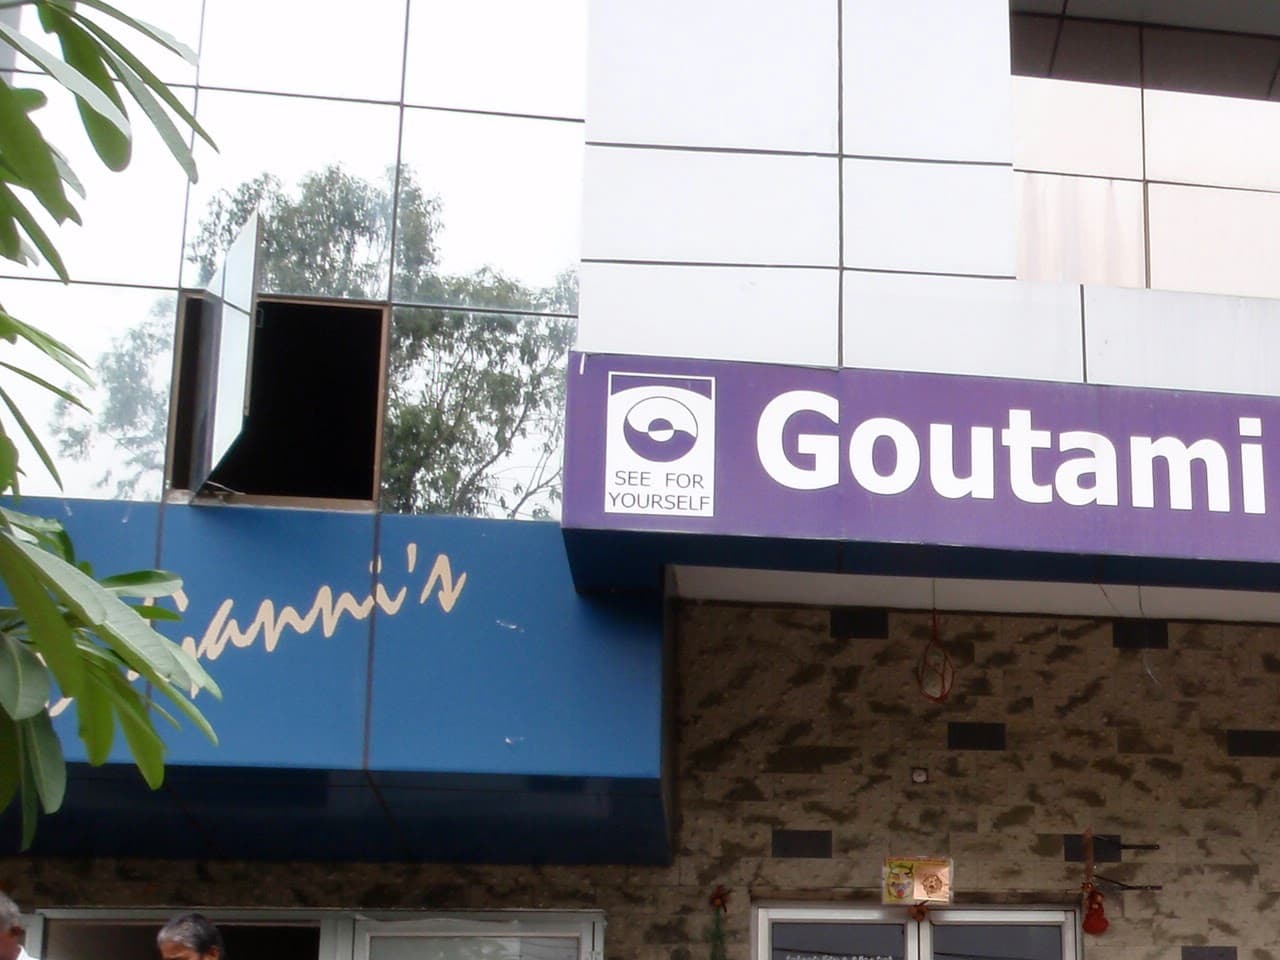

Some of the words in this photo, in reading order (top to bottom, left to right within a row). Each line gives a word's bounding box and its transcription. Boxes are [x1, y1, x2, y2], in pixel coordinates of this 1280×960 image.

[615, 470, 651, 487] SEE
[666, 473, 704, 489] FOR
[757, 390, 1266, 514] Goutami
[608, 491, 711, 512] YOURSELF
[110, 542, 468, 697] anni's
